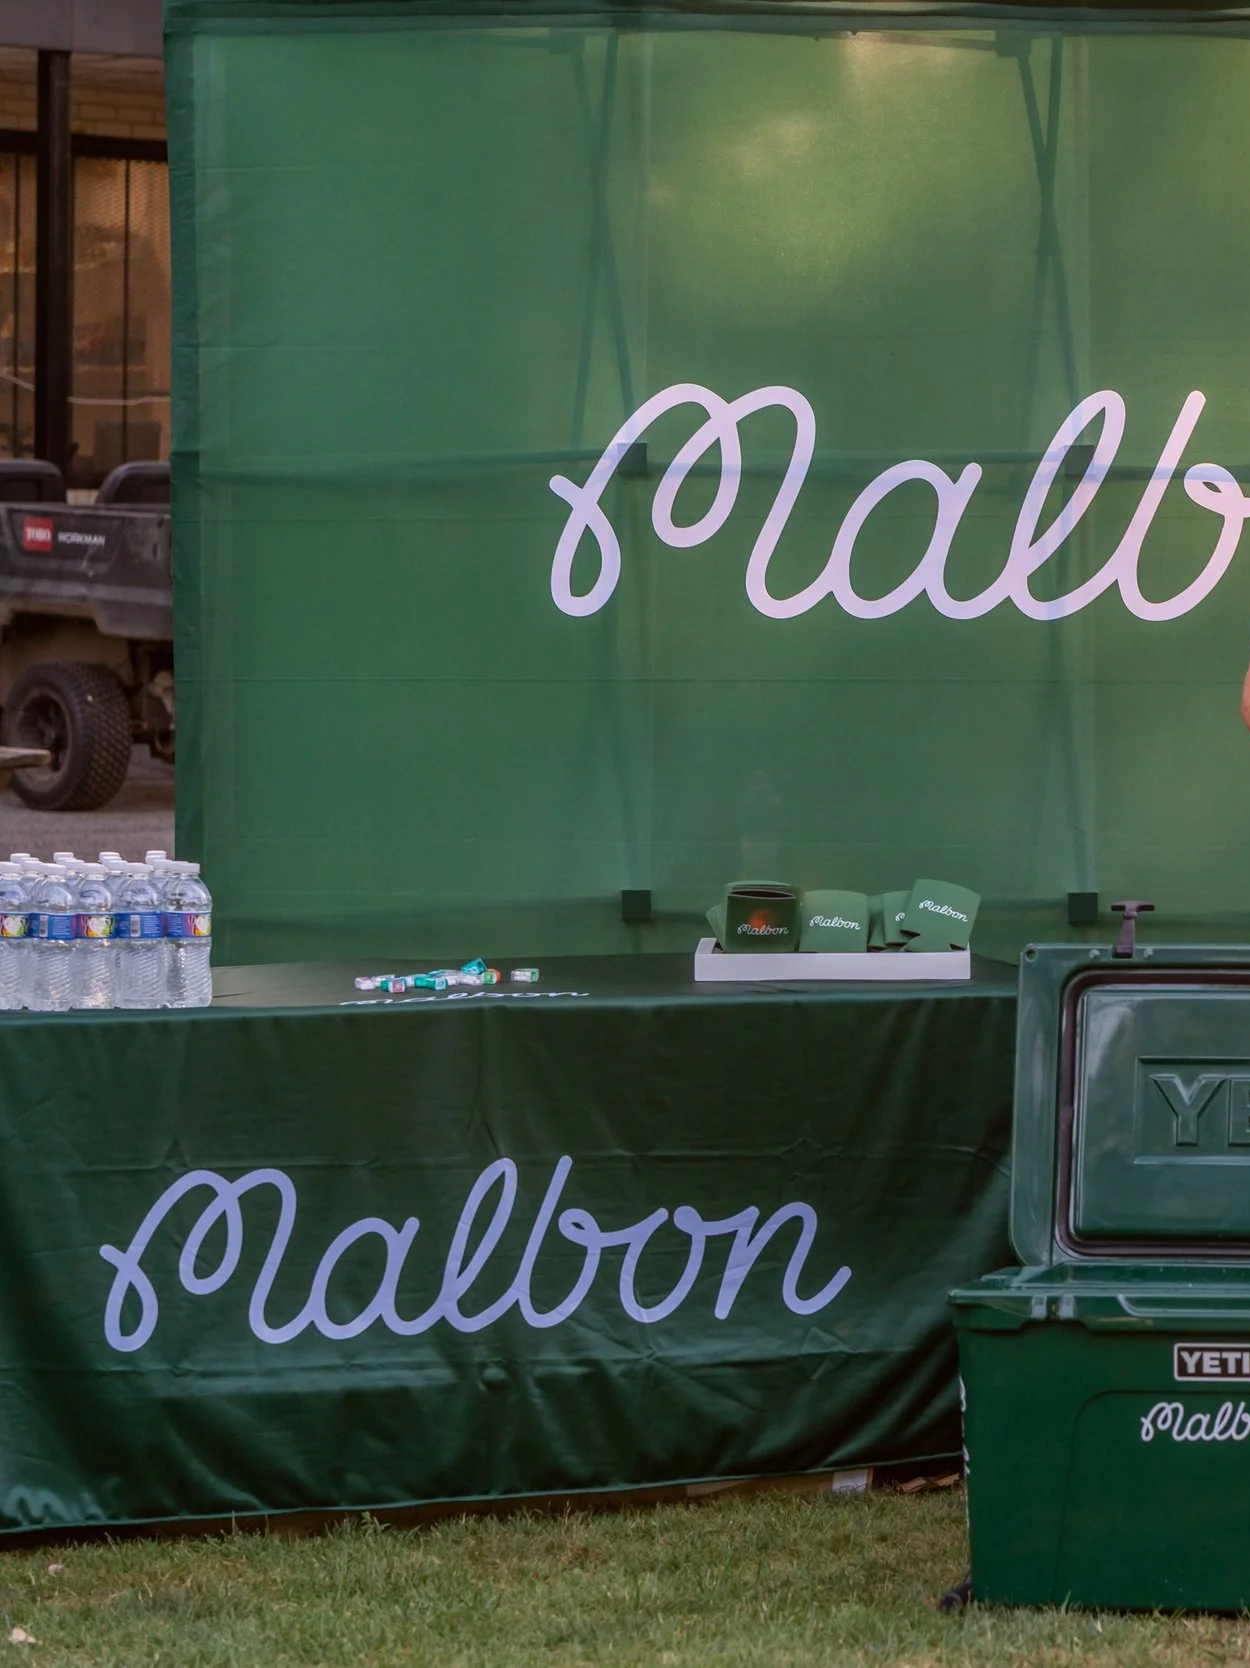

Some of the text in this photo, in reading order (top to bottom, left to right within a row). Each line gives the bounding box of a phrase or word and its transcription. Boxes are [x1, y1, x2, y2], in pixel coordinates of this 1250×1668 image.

[58, 531, 105, 546] WORKMAN
[914, 899, 968, 923] Malbon
[737, 923, 789, 937] Malbon
[809, 915, 861, 931] Malbon
[99, 1155, 853, 1353] Malbon
